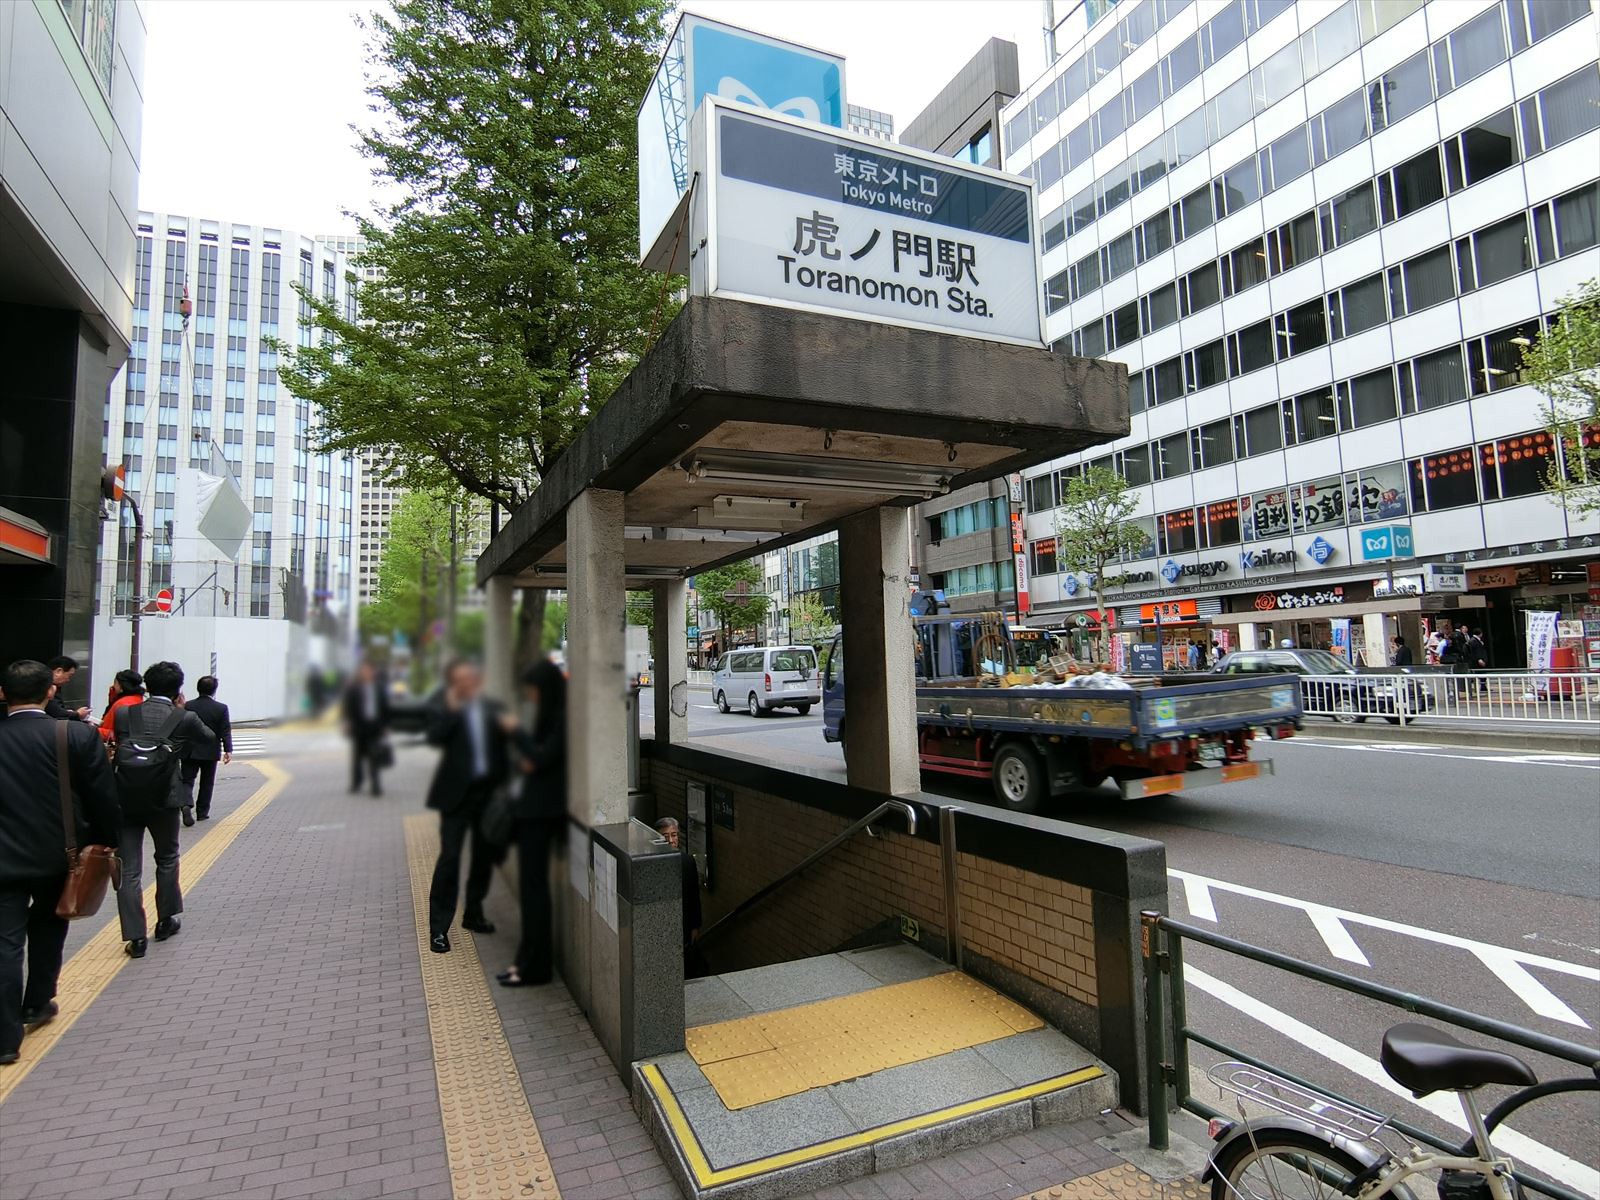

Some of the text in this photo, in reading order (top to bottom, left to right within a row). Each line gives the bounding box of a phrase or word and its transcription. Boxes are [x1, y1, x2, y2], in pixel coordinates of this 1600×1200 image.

[833, 153, 938, 197] 東京メトロ
[841, 181, 933, 215] Tokyo Metro
[793, 210, 979, 287] 虎ノ門駅
[777, 255, 994, 319] Toranomon Sta.
[1239, 548, 1297, 569] Kaikan
[1277, 591, 1343, 608] はなまるうどん
